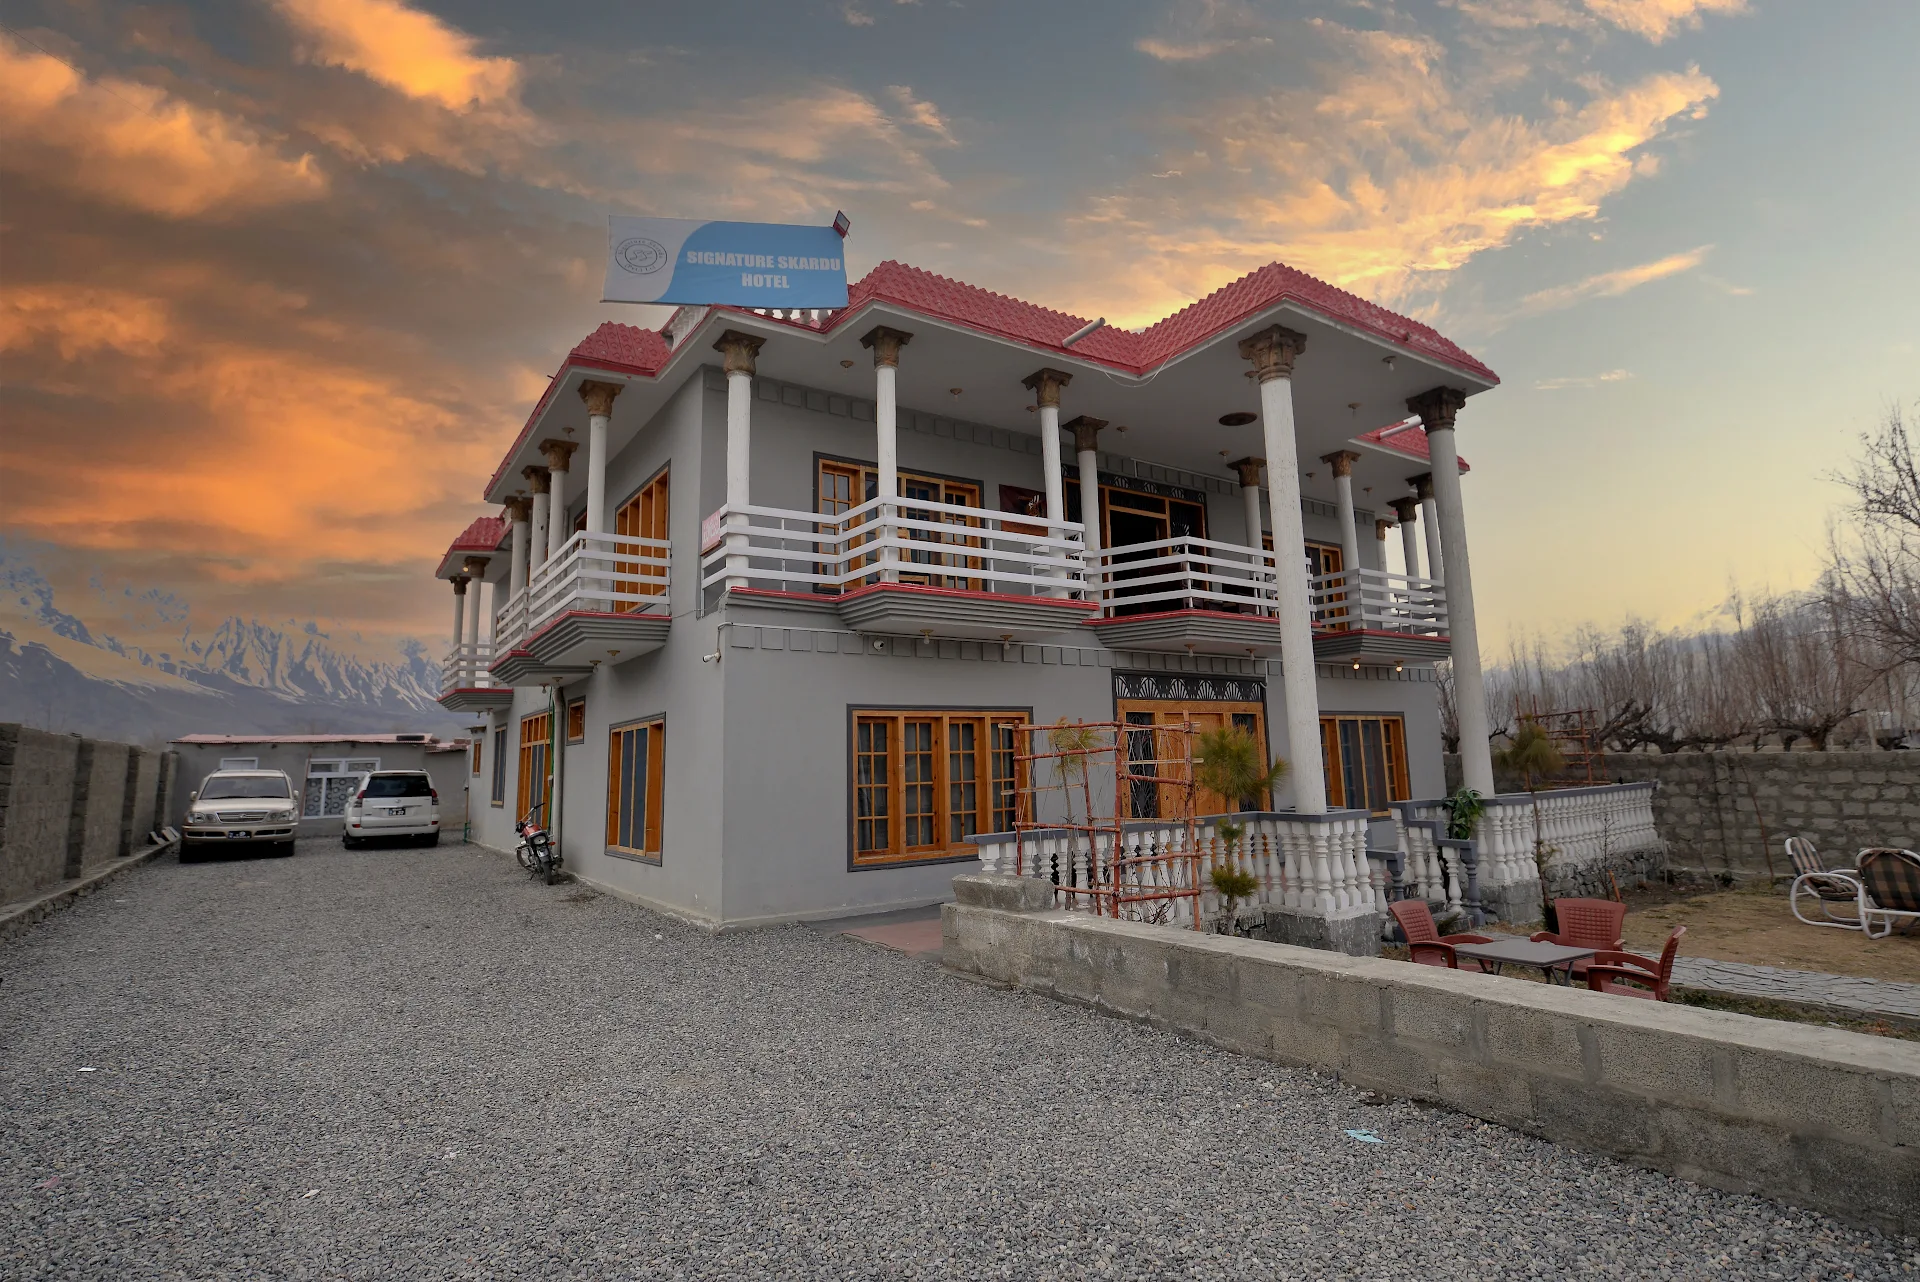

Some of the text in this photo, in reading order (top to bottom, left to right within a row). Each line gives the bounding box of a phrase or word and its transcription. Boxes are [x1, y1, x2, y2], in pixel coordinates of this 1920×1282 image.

[687, 251, 840, 271] SIGNATURE SKARDU
[742, 272, 789, 288] HOTEL
